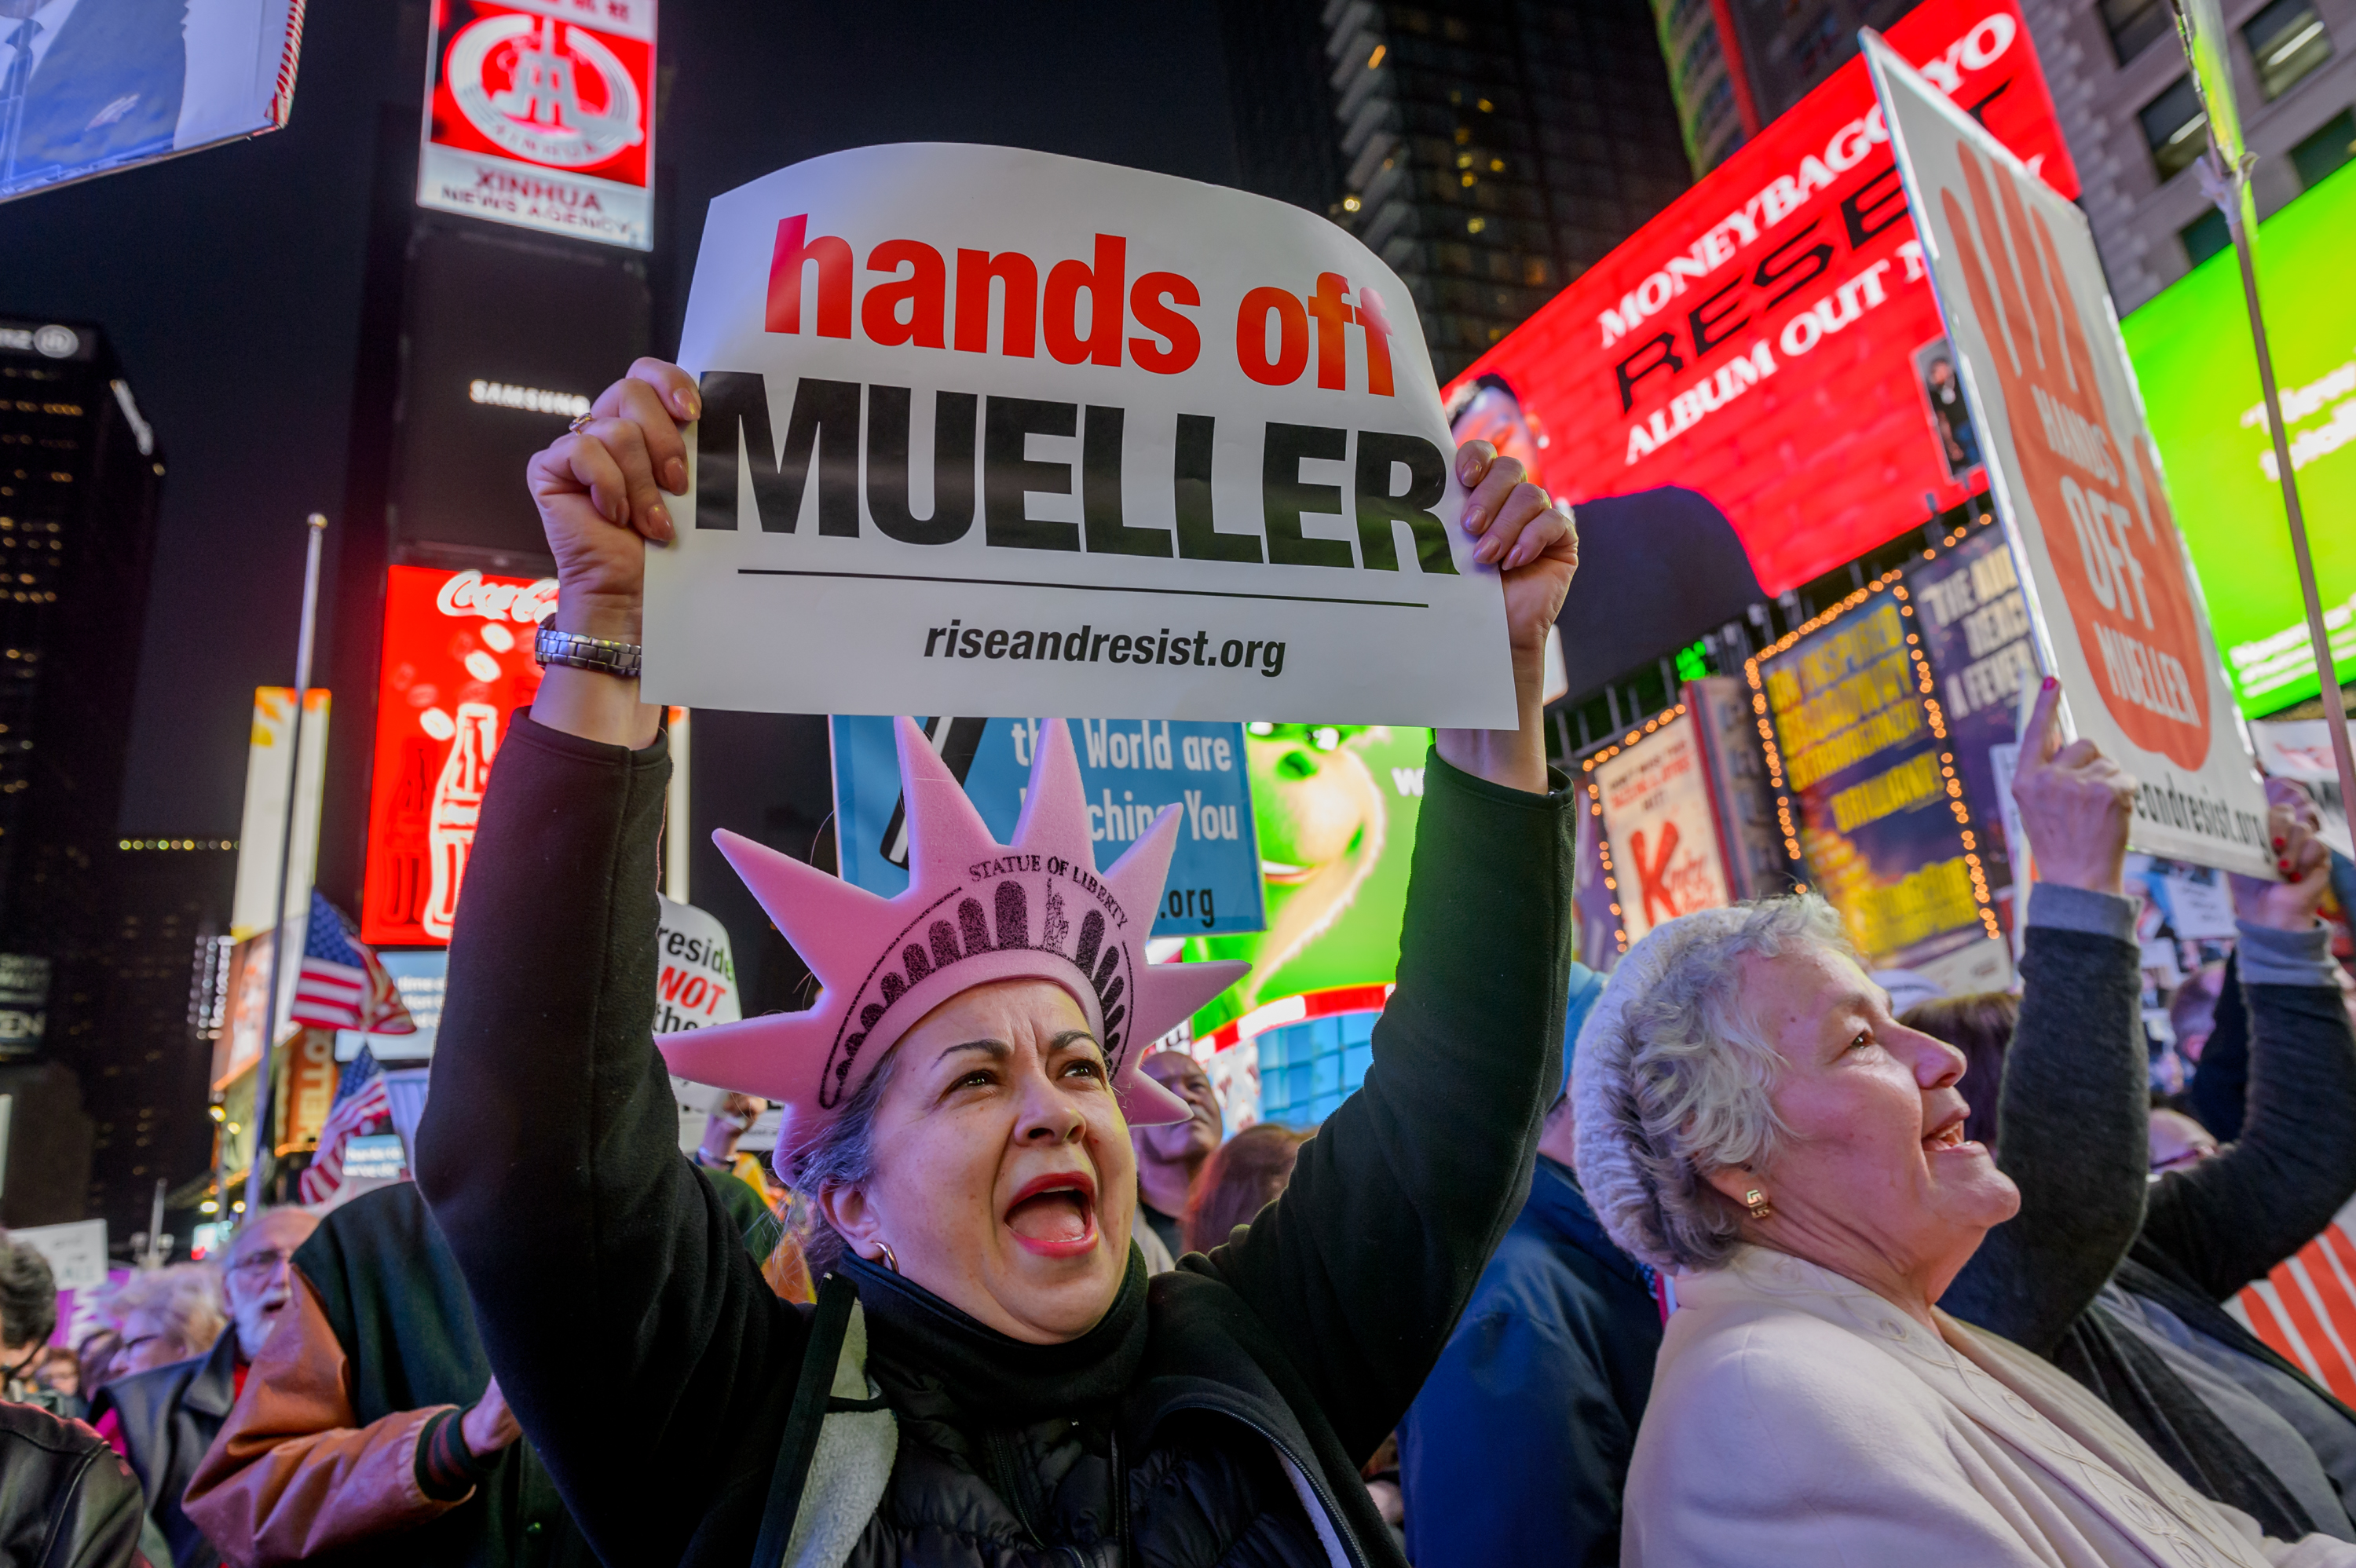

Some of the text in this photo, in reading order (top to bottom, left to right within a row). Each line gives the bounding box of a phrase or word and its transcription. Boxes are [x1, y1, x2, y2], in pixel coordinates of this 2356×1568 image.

[1917, 13, 2017, 96] YO
[474, 166, 603, 213] XINHUA
[764, 213, 1396, 397] hands off
[470, 379, 591, 418] SAMSUNG
[1625, 258, 1891, 465] ALBUM OUT
[695, 371, 1461, 576] MUELLER
[2031, 384, 2120, 488] HANDS
[2060, 475, 2155, 630] OFF
[924, 619, 1286, 678] riseandresist.org
[2093, 621, 2202, 728] MUELLER
[1081, 718, 1173, 770] World
[1182, 735, 1232, 772] are
[1183, 789, 1238, 841] You
[969, 854, 1129, 930] STATUE OF LIBERTY
[658, 965, 727, 1016] NOT
